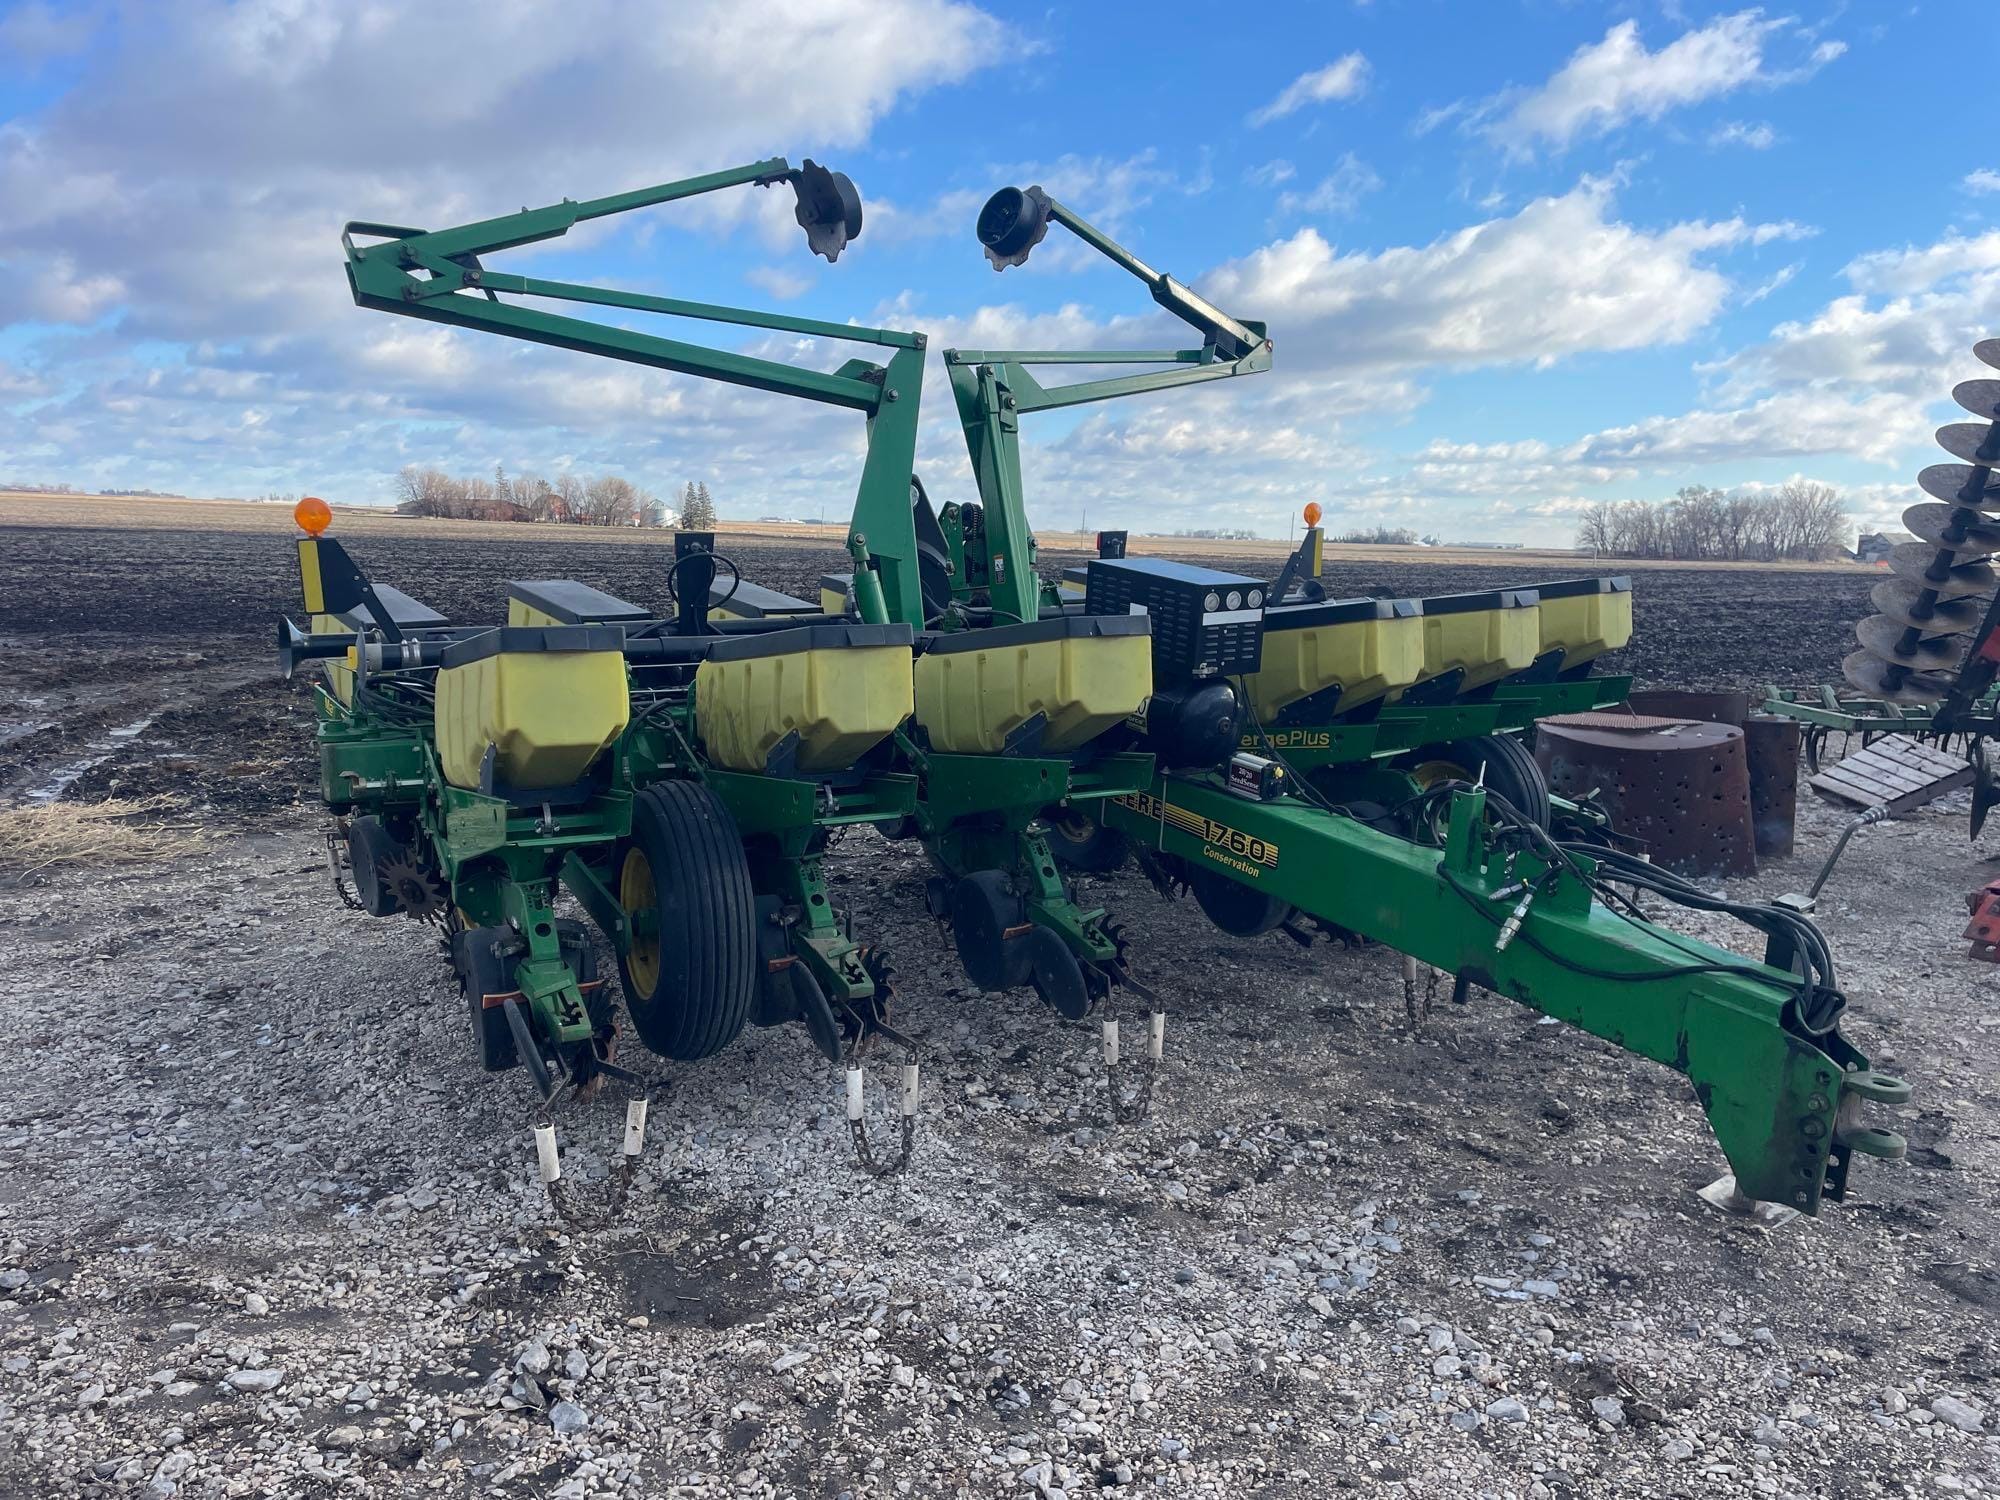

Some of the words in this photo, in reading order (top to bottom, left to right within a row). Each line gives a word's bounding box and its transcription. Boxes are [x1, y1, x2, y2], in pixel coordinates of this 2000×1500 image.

[1230, 774, 1259, 790] SeedSense
[1202, 818, 1267, 864] 1760
[1203, 845, 1260, 878] Conservation
